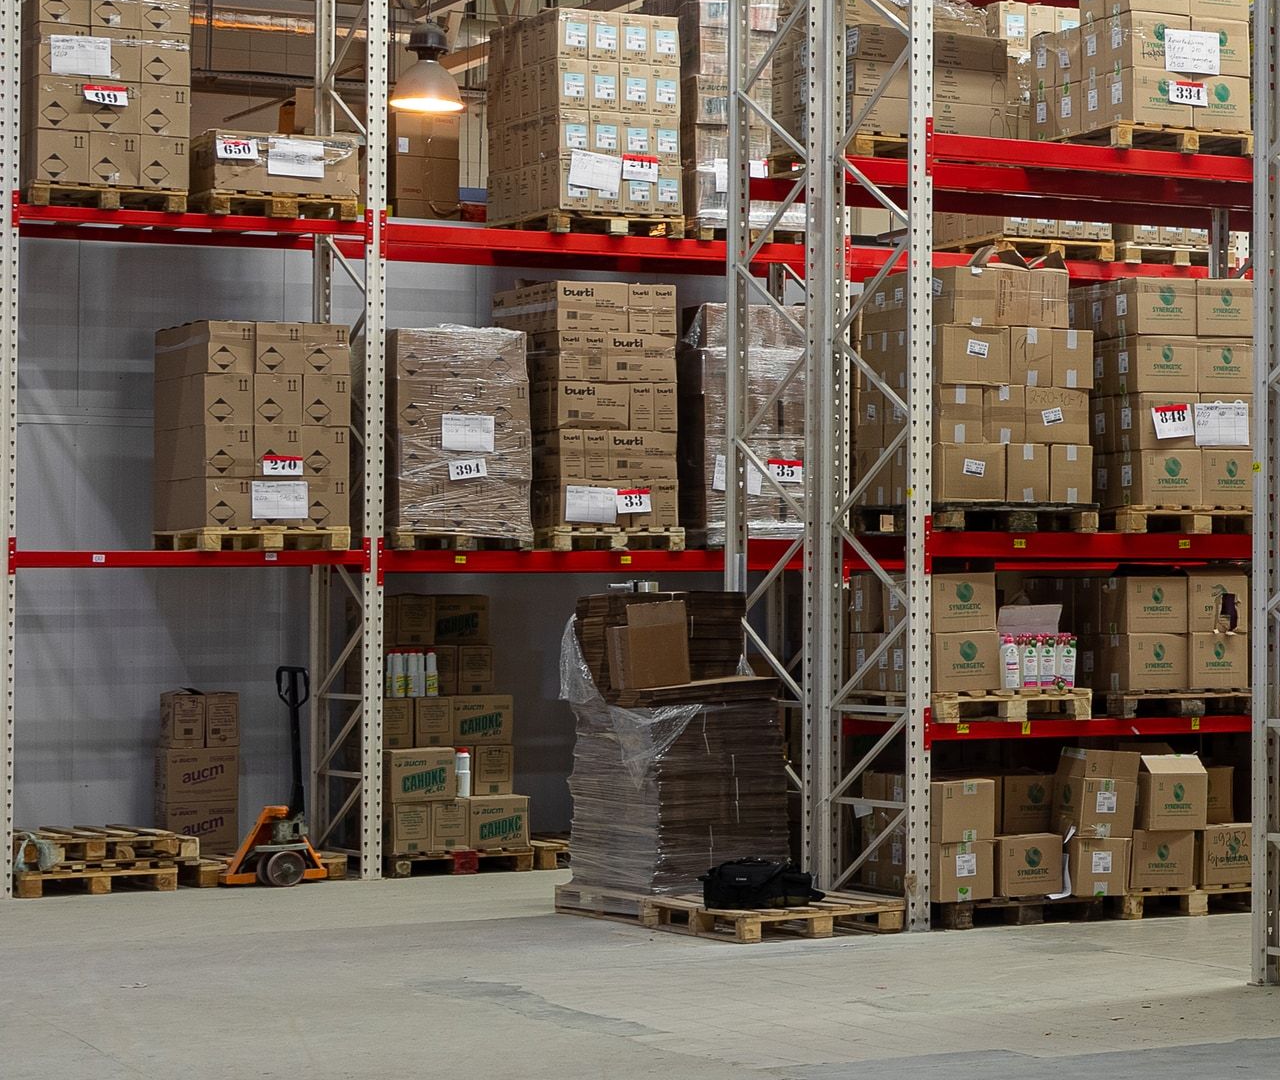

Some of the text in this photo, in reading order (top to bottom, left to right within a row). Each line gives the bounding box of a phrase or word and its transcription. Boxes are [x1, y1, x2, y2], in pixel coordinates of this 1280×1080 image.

[95, 91, 118, 104] 99
[1176, 87, 1201, 100] 334
[224, 143, 251, 155] 650
[563, 287, 594, 297] burti
[1152, 306, 1183, 314] SYNERGETIC
[1213, 307, 1241, 315] SYNERGETIC
[613, 338, 643, 348] burti
[565, 385, 596, 395] burti
[1160, 410, 1186, 423] 848
[587, 434, 605, 442] burti
[613, 436, 643, 446] burti
[269, 459, 297, 471] 270
[455, 463, 481, 476] 394
[776, 465, 795, 477] 35
[624, 494, 643, 508] 33
[949, 603, 981, 611] SYNERGETIC
[952, 662, 985, 670] SYNERGETIC
[1145, 661, 1174, 669] SYNERGETIC
[182, 762, 225, 784] aucm
[1017, 868, 1049, 876] SYNERGETIC
